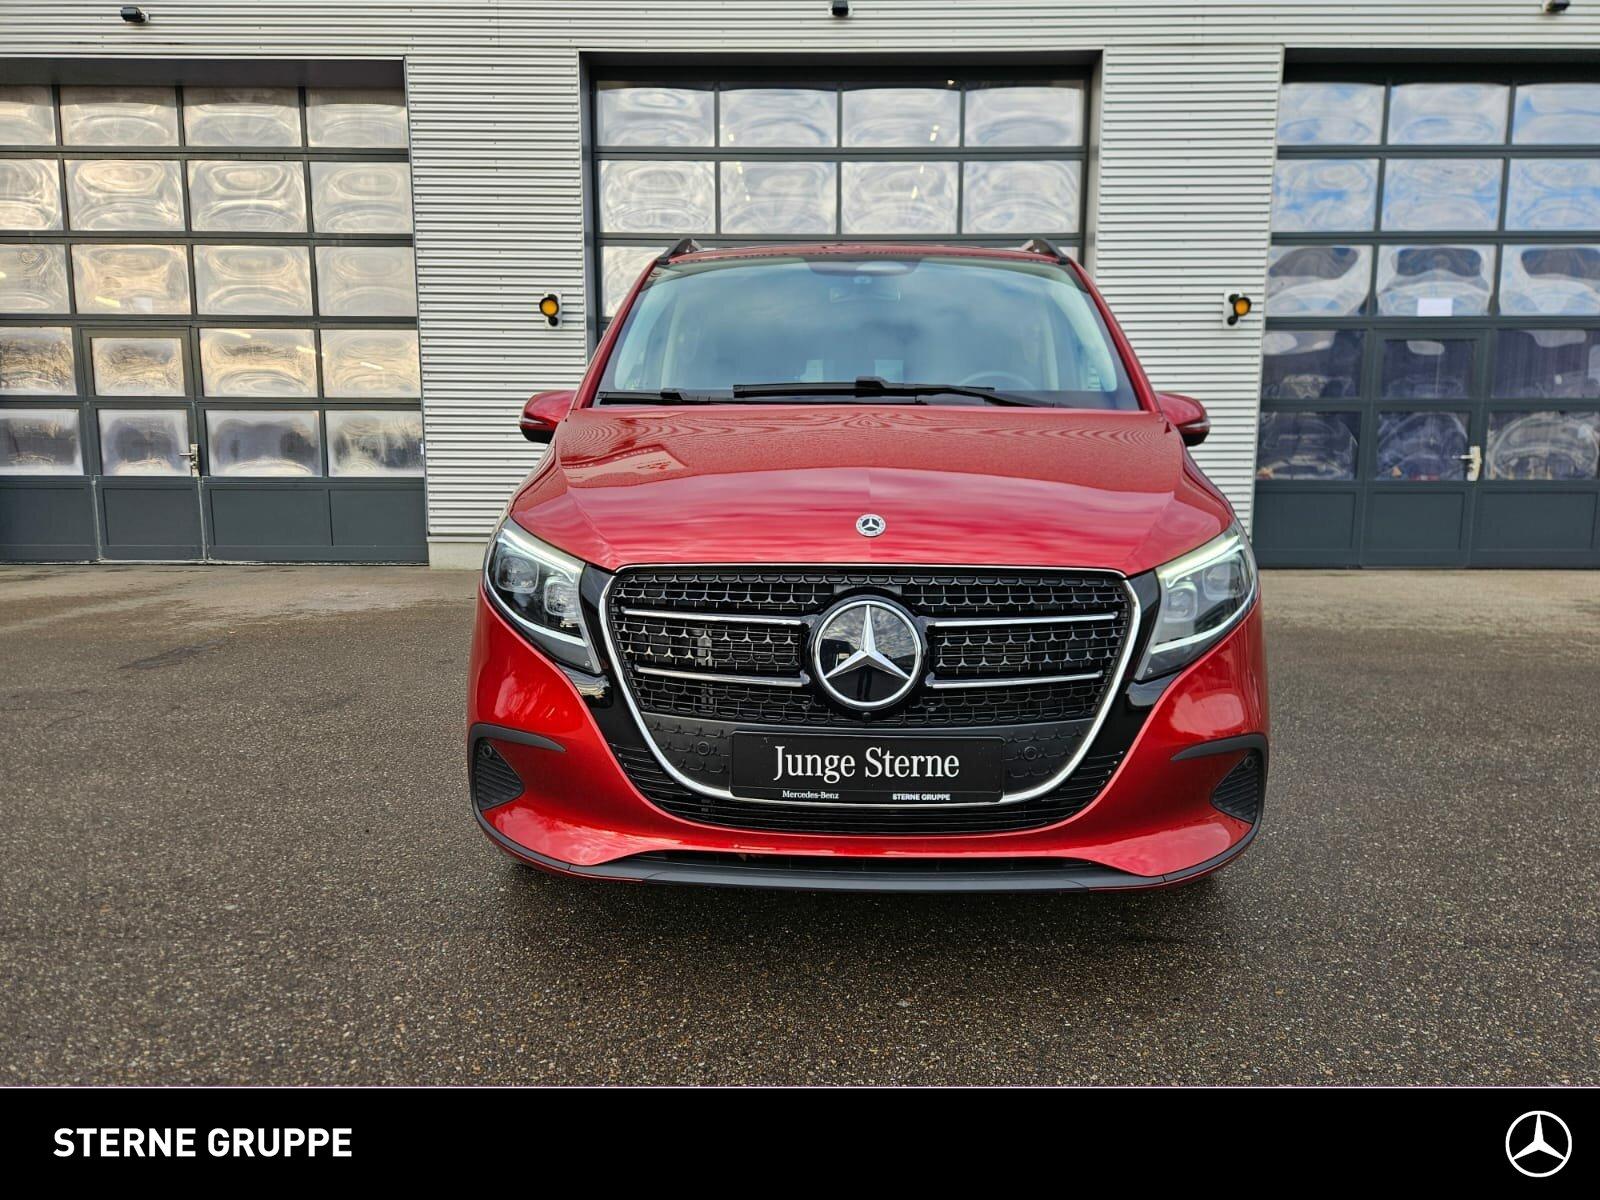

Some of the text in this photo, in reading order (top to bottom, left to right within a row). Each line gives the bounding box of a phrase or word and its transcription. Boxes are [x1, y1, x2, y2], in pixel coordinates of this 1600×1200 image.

[773, 745, 960, 784] Junge Sterne
[782, 789, 840, 800] Mercedes-Benz
[892, 793, 951, 801] STERNE GRUPPE
